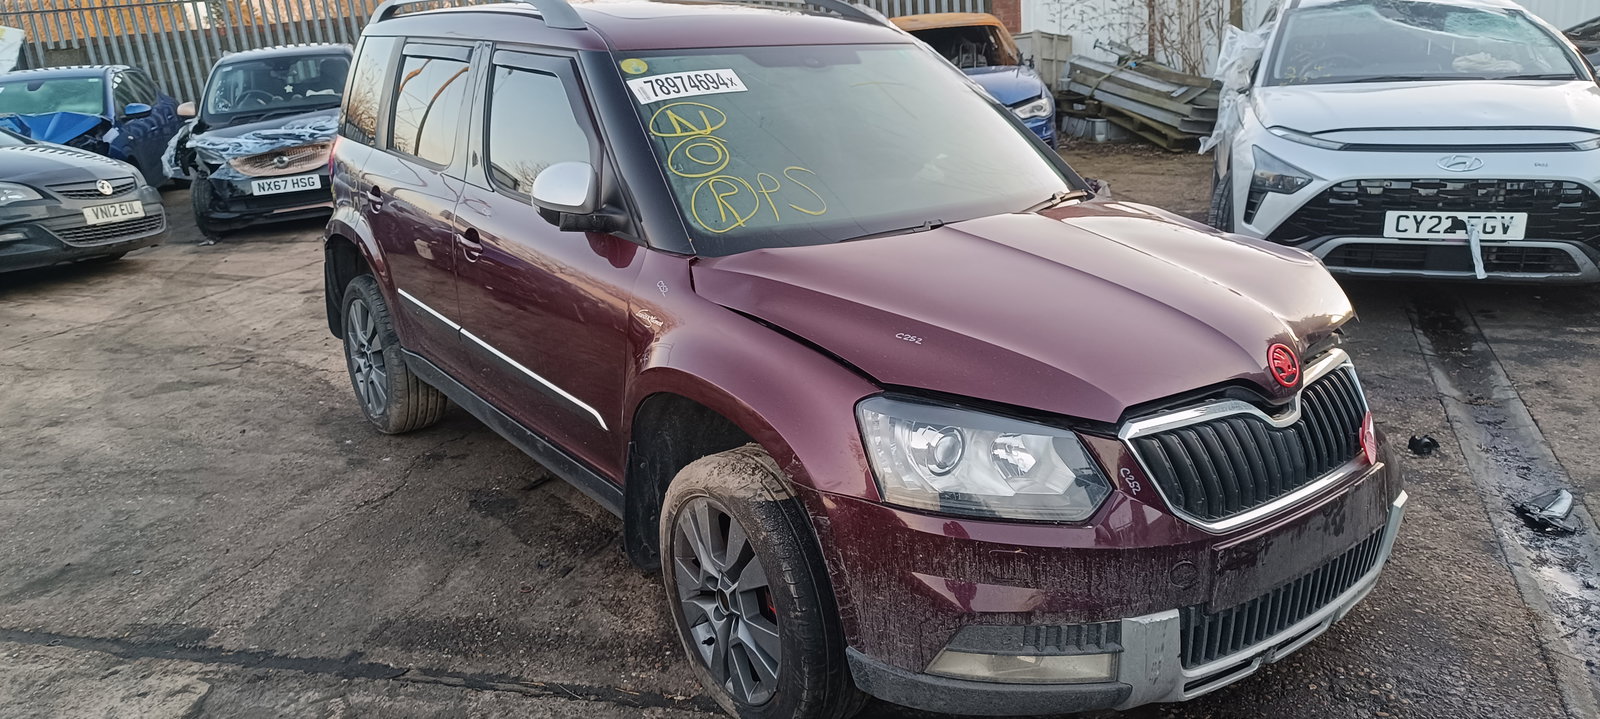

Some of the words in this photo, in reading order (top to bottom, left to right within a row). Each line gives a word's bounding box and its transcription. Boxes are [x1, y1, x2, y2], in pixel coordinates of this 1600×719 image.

[257, 180, 288, 192] NX67
[291, 176, 316, 188] HSG
[91, 205, 119, 220] VN12
[119, 202, 139, 216] EUL
[1395, 215, 1459, 234] CY22
[895, 332, 923, 345] C252
[1120, 467, 1141, 496] C252
